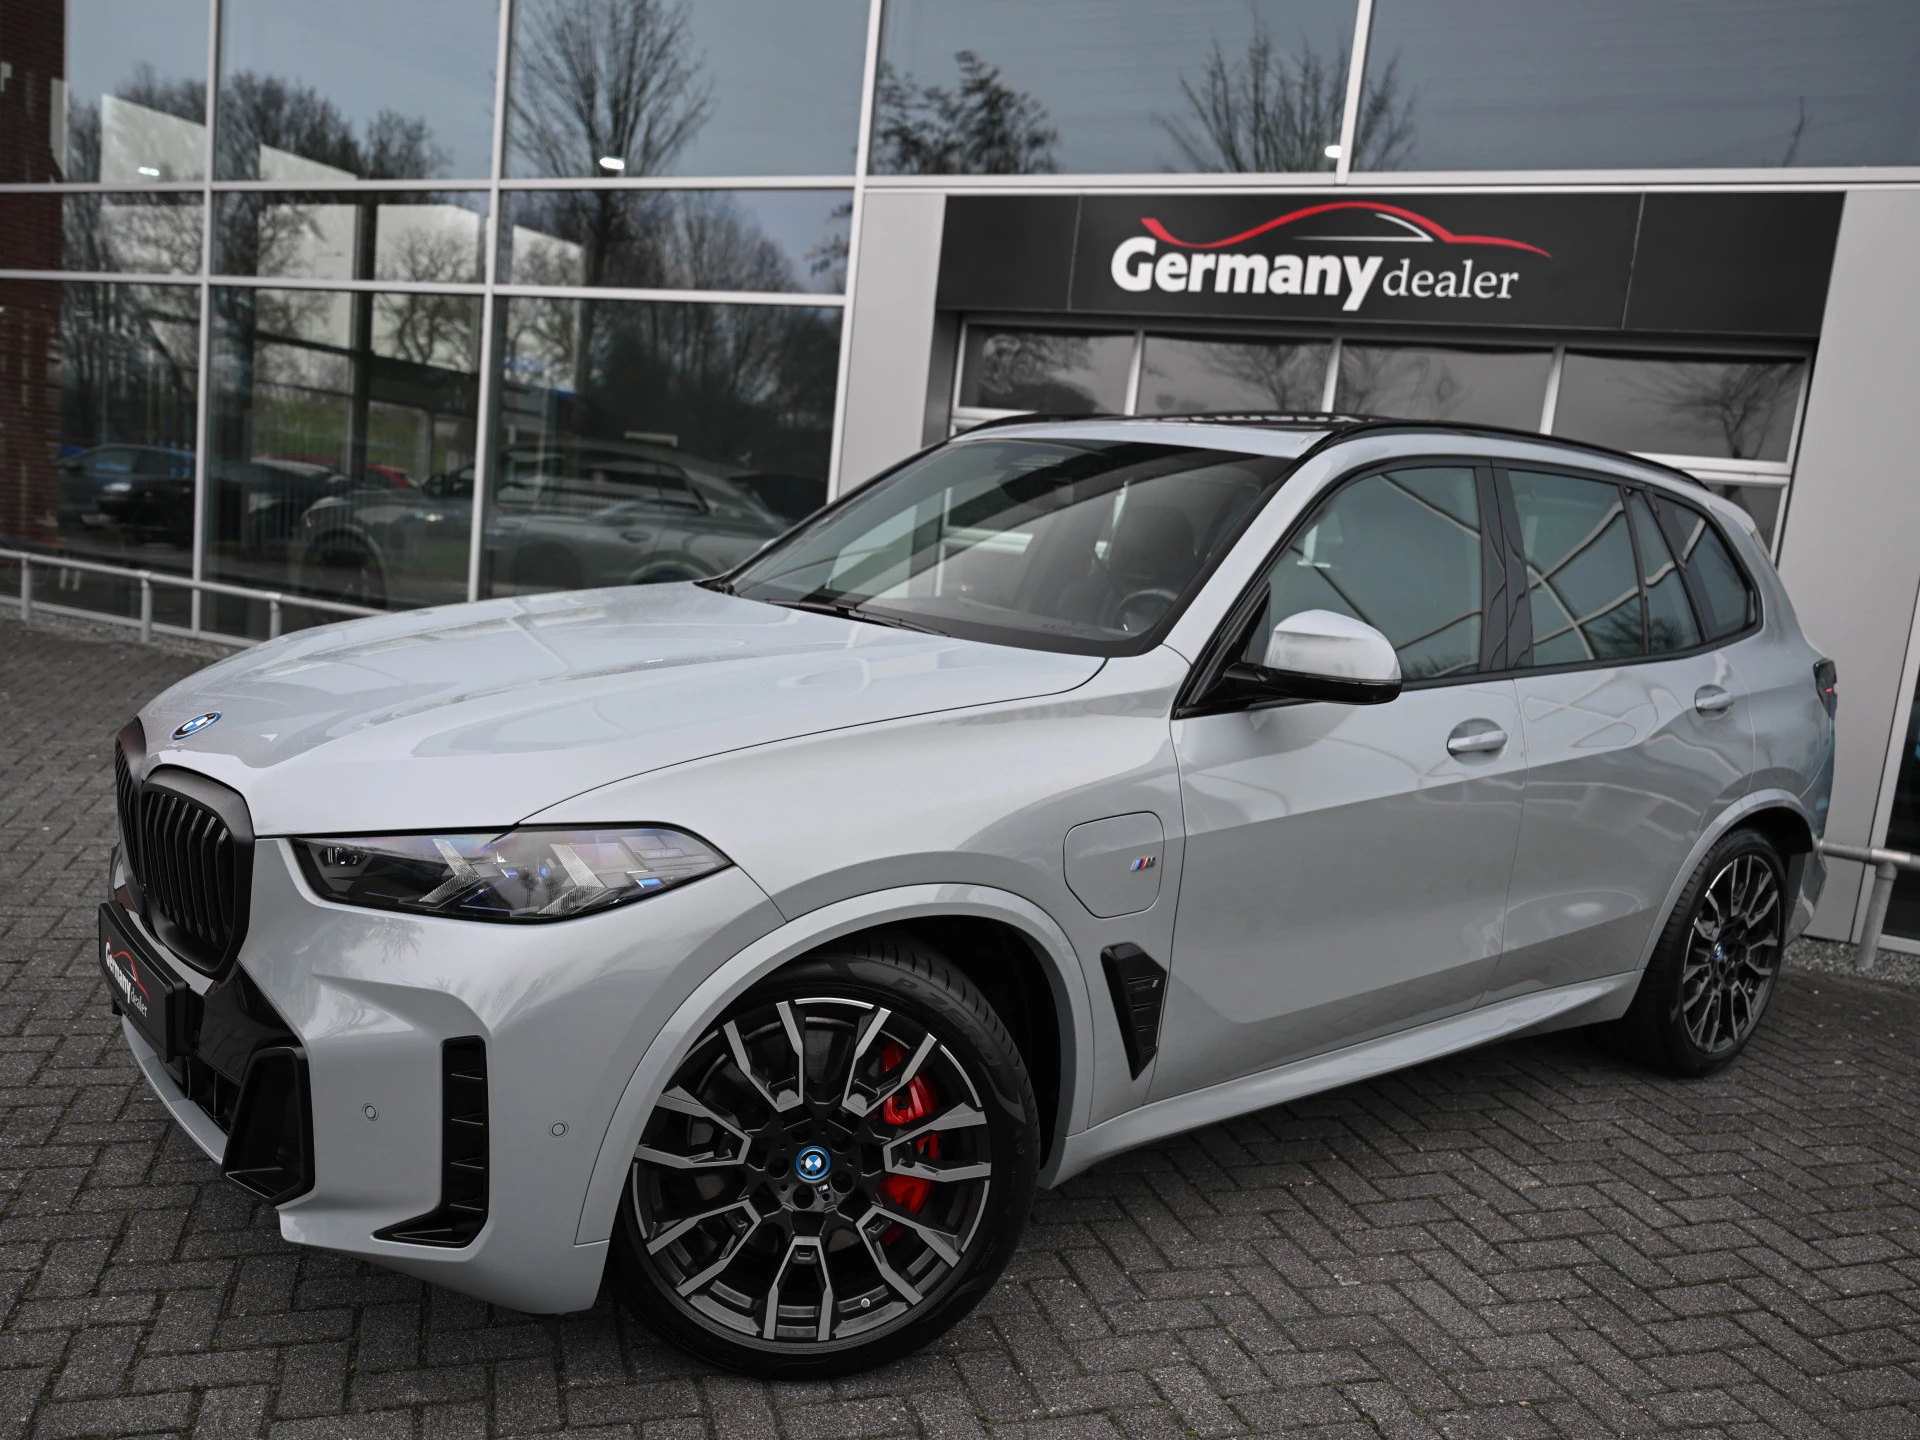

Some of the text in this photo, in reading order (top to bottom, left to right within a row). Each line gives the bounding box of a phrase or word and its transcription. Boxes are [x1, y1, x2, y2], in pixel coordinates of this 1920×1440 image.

[1110, 236, 1519, 311] Germany dealer
[105, 942, 147, 1018] Germany dealer
